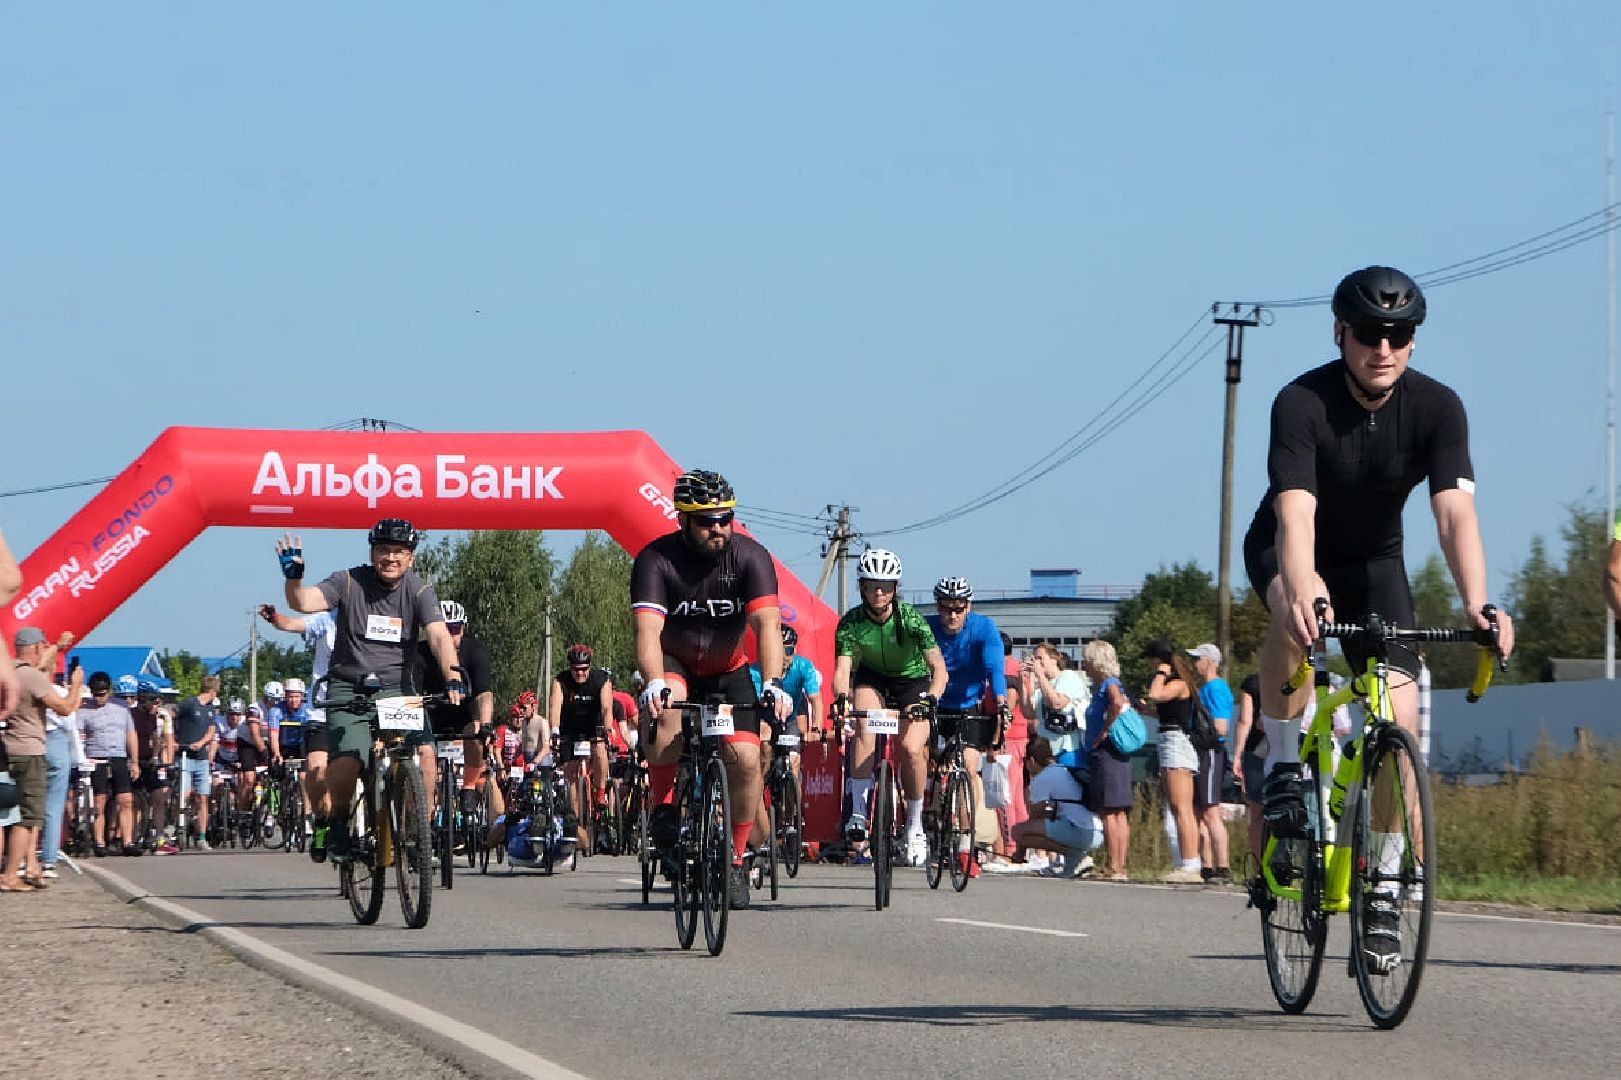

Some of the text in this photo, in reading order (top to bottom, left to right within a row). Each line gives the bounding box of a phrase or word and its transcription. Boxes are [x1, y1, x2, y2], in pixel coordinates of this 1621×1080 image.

[251, 450, 565, 508] Альфа Банк
[13, 474, 174, 620] GRAN FONDO
[68, 525, 151, 598] RUSSIA
